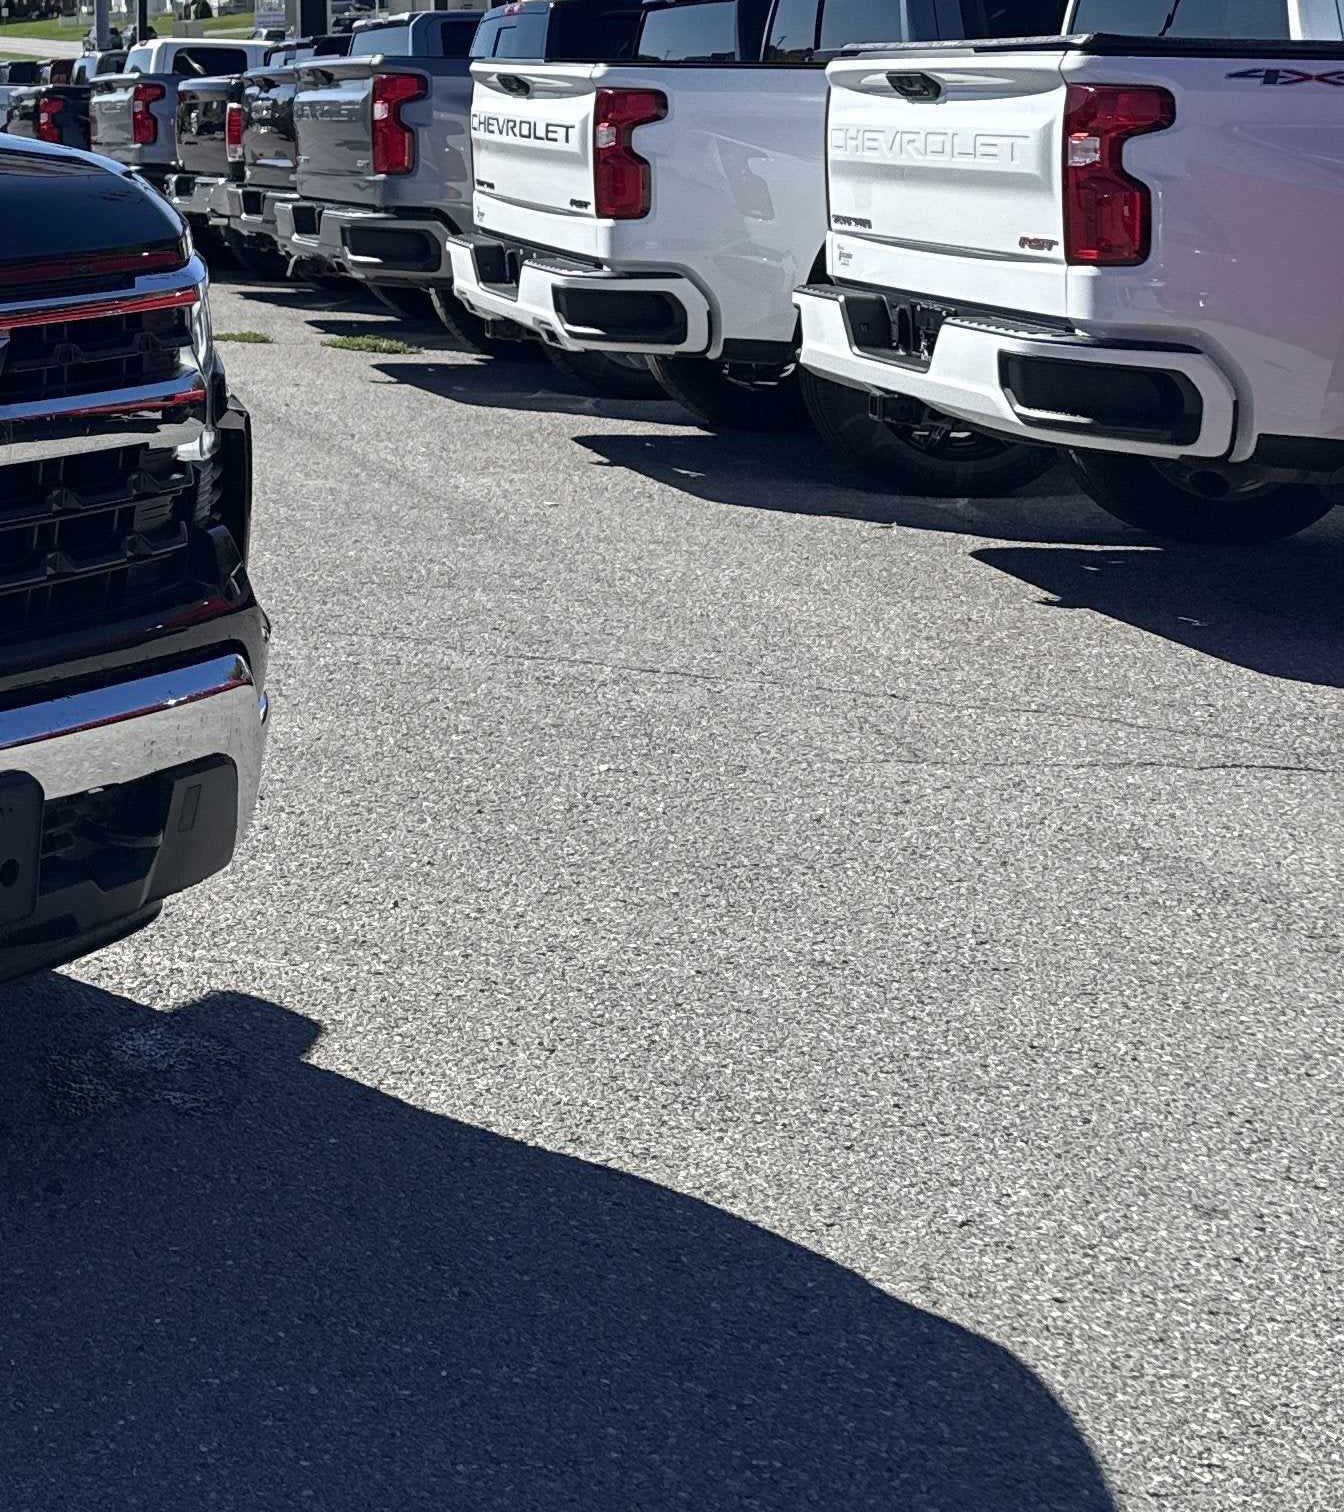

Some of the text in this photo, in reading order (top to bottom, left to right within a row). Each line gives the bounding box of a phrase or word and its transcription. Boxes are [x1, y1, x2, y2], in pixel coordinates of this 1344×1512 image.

[1224, 68, 1344, 86] 4X
[472, 113, 575, 144] CHEVROLET
[830, 127, 1031, 166] CHEVROLET
